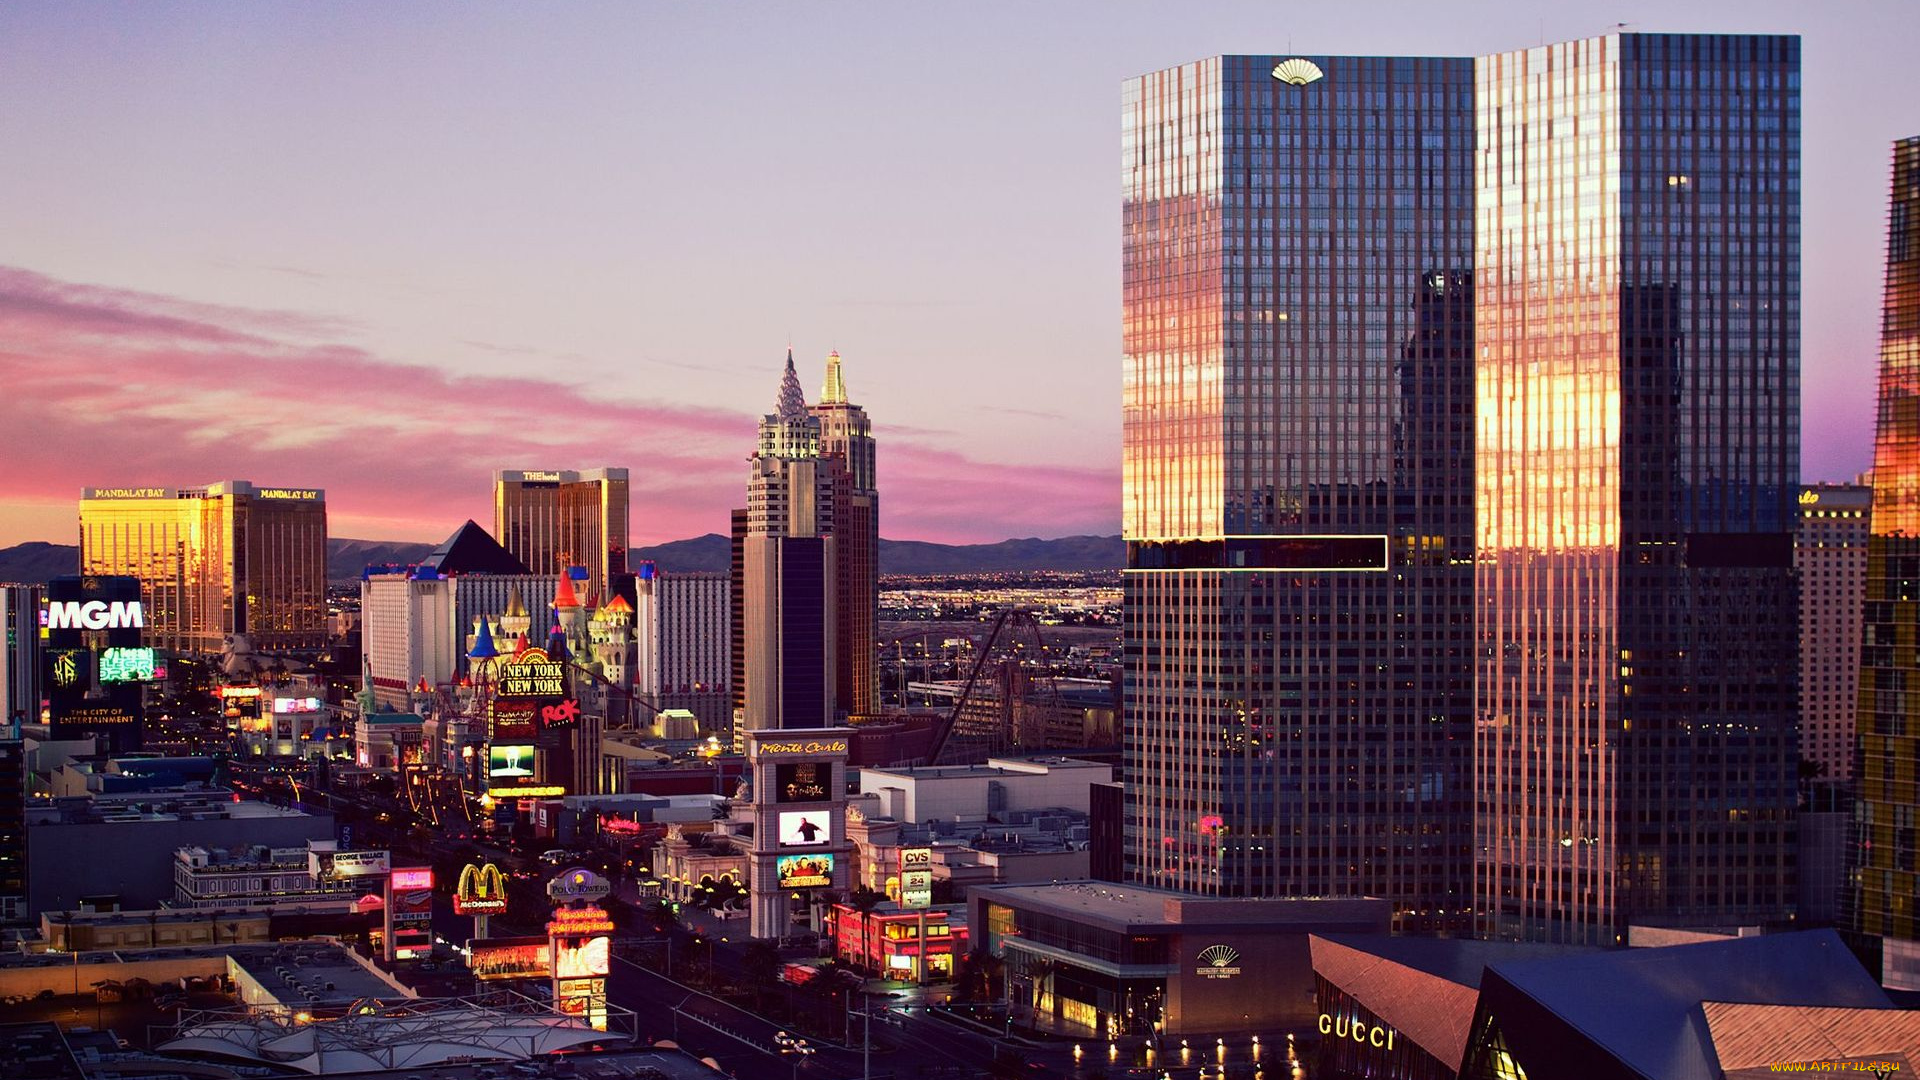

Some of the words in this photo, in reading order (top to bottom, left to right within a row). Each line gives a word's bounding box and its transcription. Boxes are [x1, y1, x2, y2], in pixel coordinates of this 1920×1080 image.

[95, 489, 146, 498] MANDALAY
[148, 488, 165, 498] BAY
[261, 490, 301, 499] MANDALAY
[303, 491, 316, 499] BAY
[48, 600, 144, 630] MGM
[507, 665, 531, 677] NEW
[534, 664, 563, 677] YORK
[507, 680, 531, 692] NEW
[534, 679, 563, 692] YORK
[60, 716, 134, 724] ENTERTAINMENT
[760, 742, 802, 755] Monte
[804, 741, 847, 754] Carlo
[359, 852, 384, 860] WALLACE
[905, 852, 928, 863] CVS
[910, 877, 925, 885] 24
[1318, 1013, 1394, 1051] GUCCI
